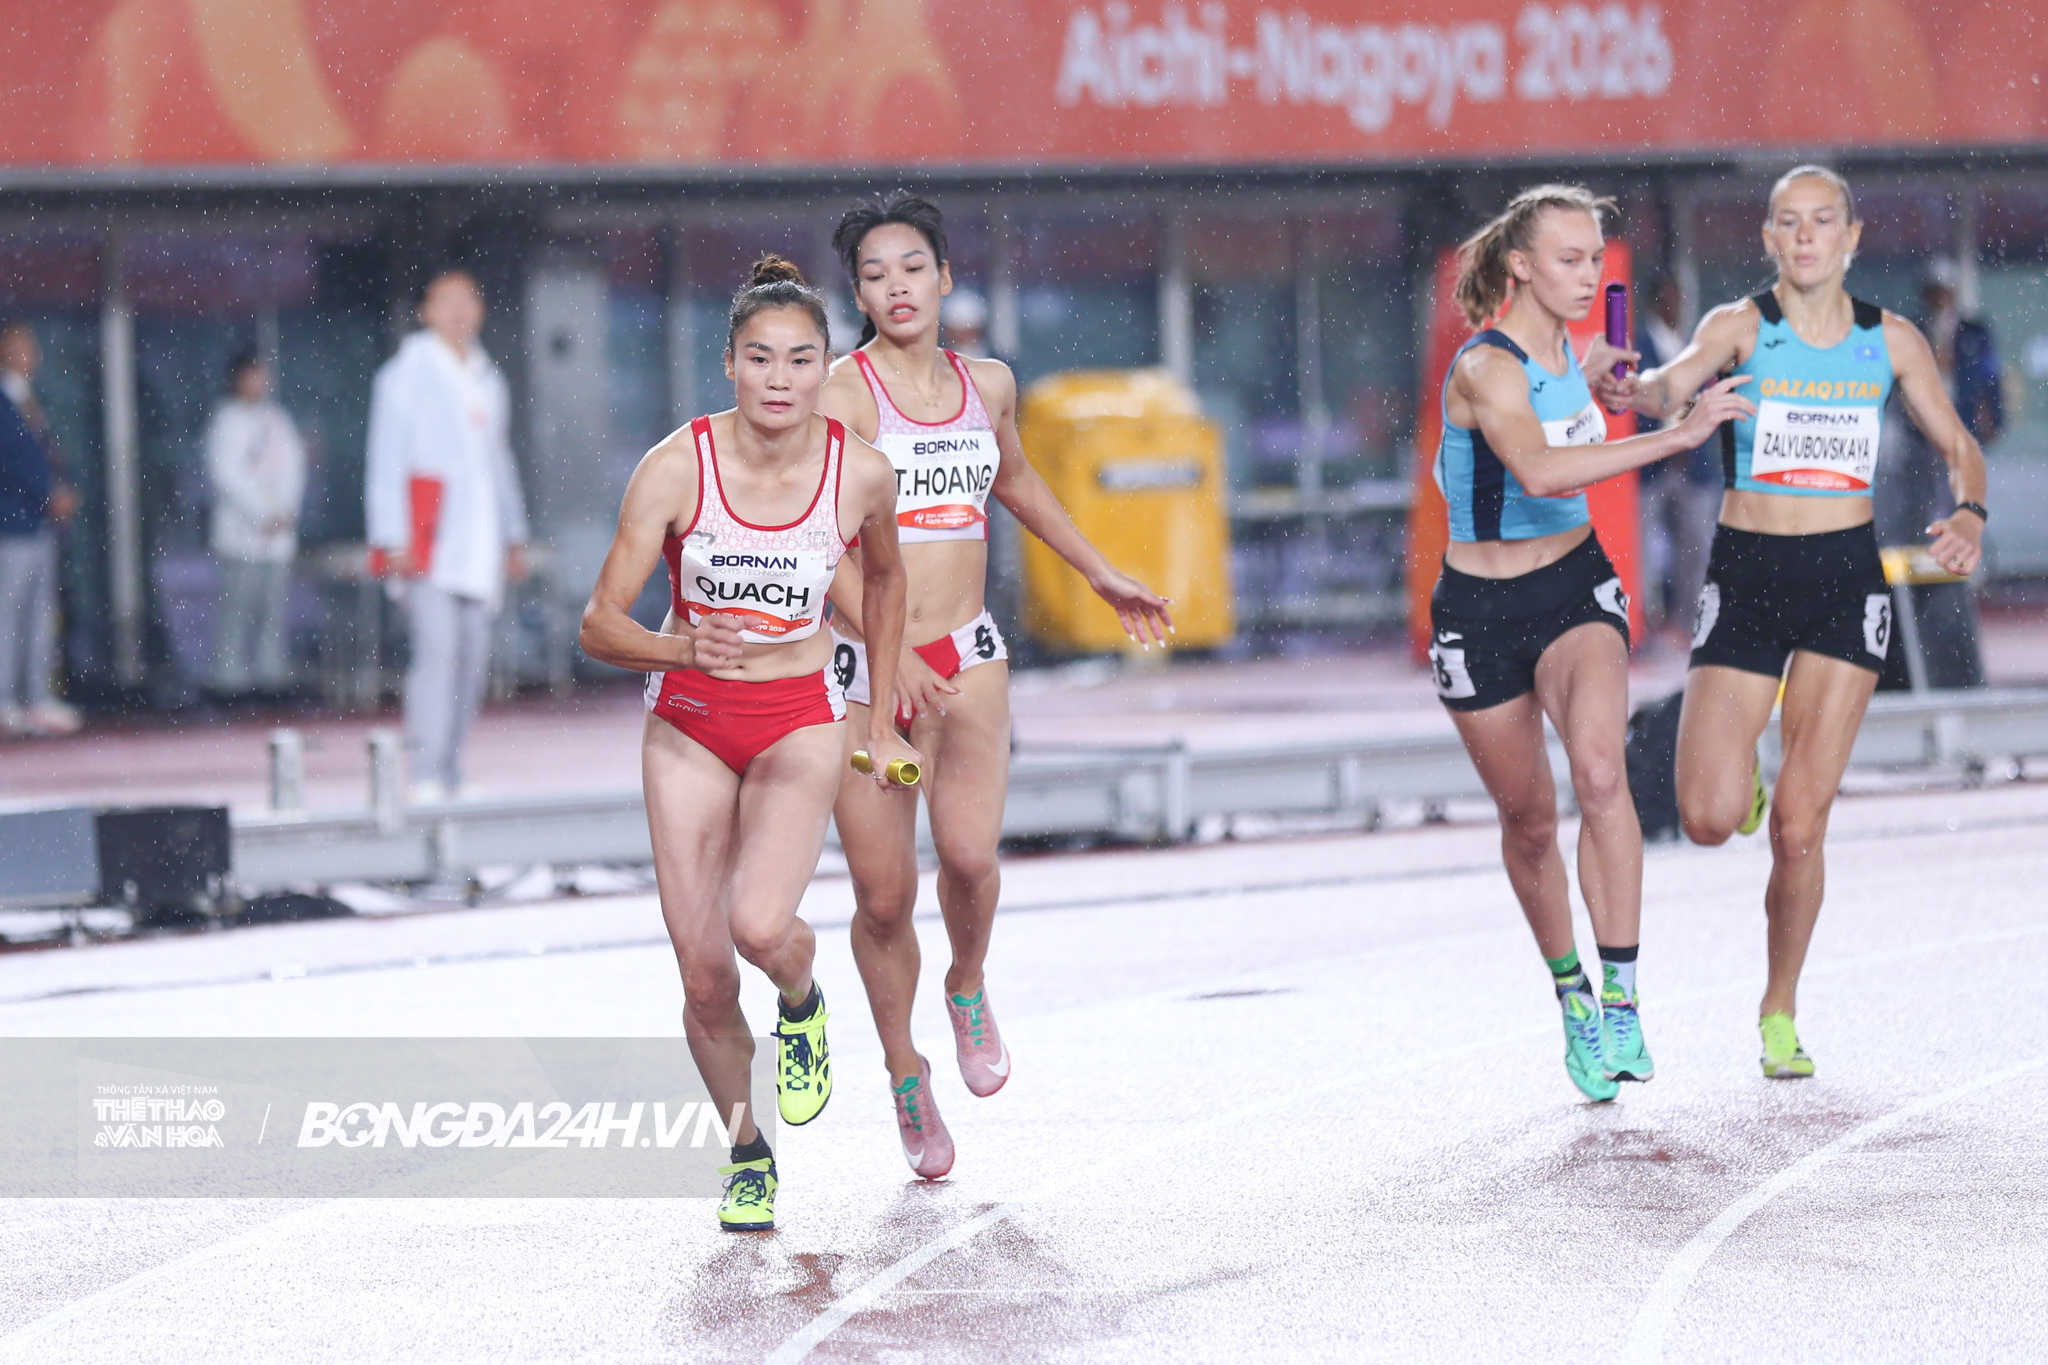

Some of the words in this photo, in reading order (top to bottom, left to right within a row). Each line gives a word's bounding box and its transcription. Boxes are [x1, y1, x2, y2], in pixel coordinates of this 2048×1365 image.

[1056, 2, 1505, 133] Aichi-Nagoya
[1515, 3, 1674, 100] 2026
[1760, 377, 1883, 401] QAZAQSTAN
[1787, 411, 1859, 426] BORNAN
[912, 438, 980, 455] BORNAN
[1763, 432, 1870, 461] ZALYUBOVSKAYA
[895, 464, 992, 496] T.HOANG
[709, 554, 798, 570] BORNAN
[744, 570, 797, 578] TECHNOLOGY
[695, 576, 809, 607] QUACH
[769, 625, 787, 633] 2026
[834, 644, 857, 701] 9
[668, 700, 710, 716] LI-NING
